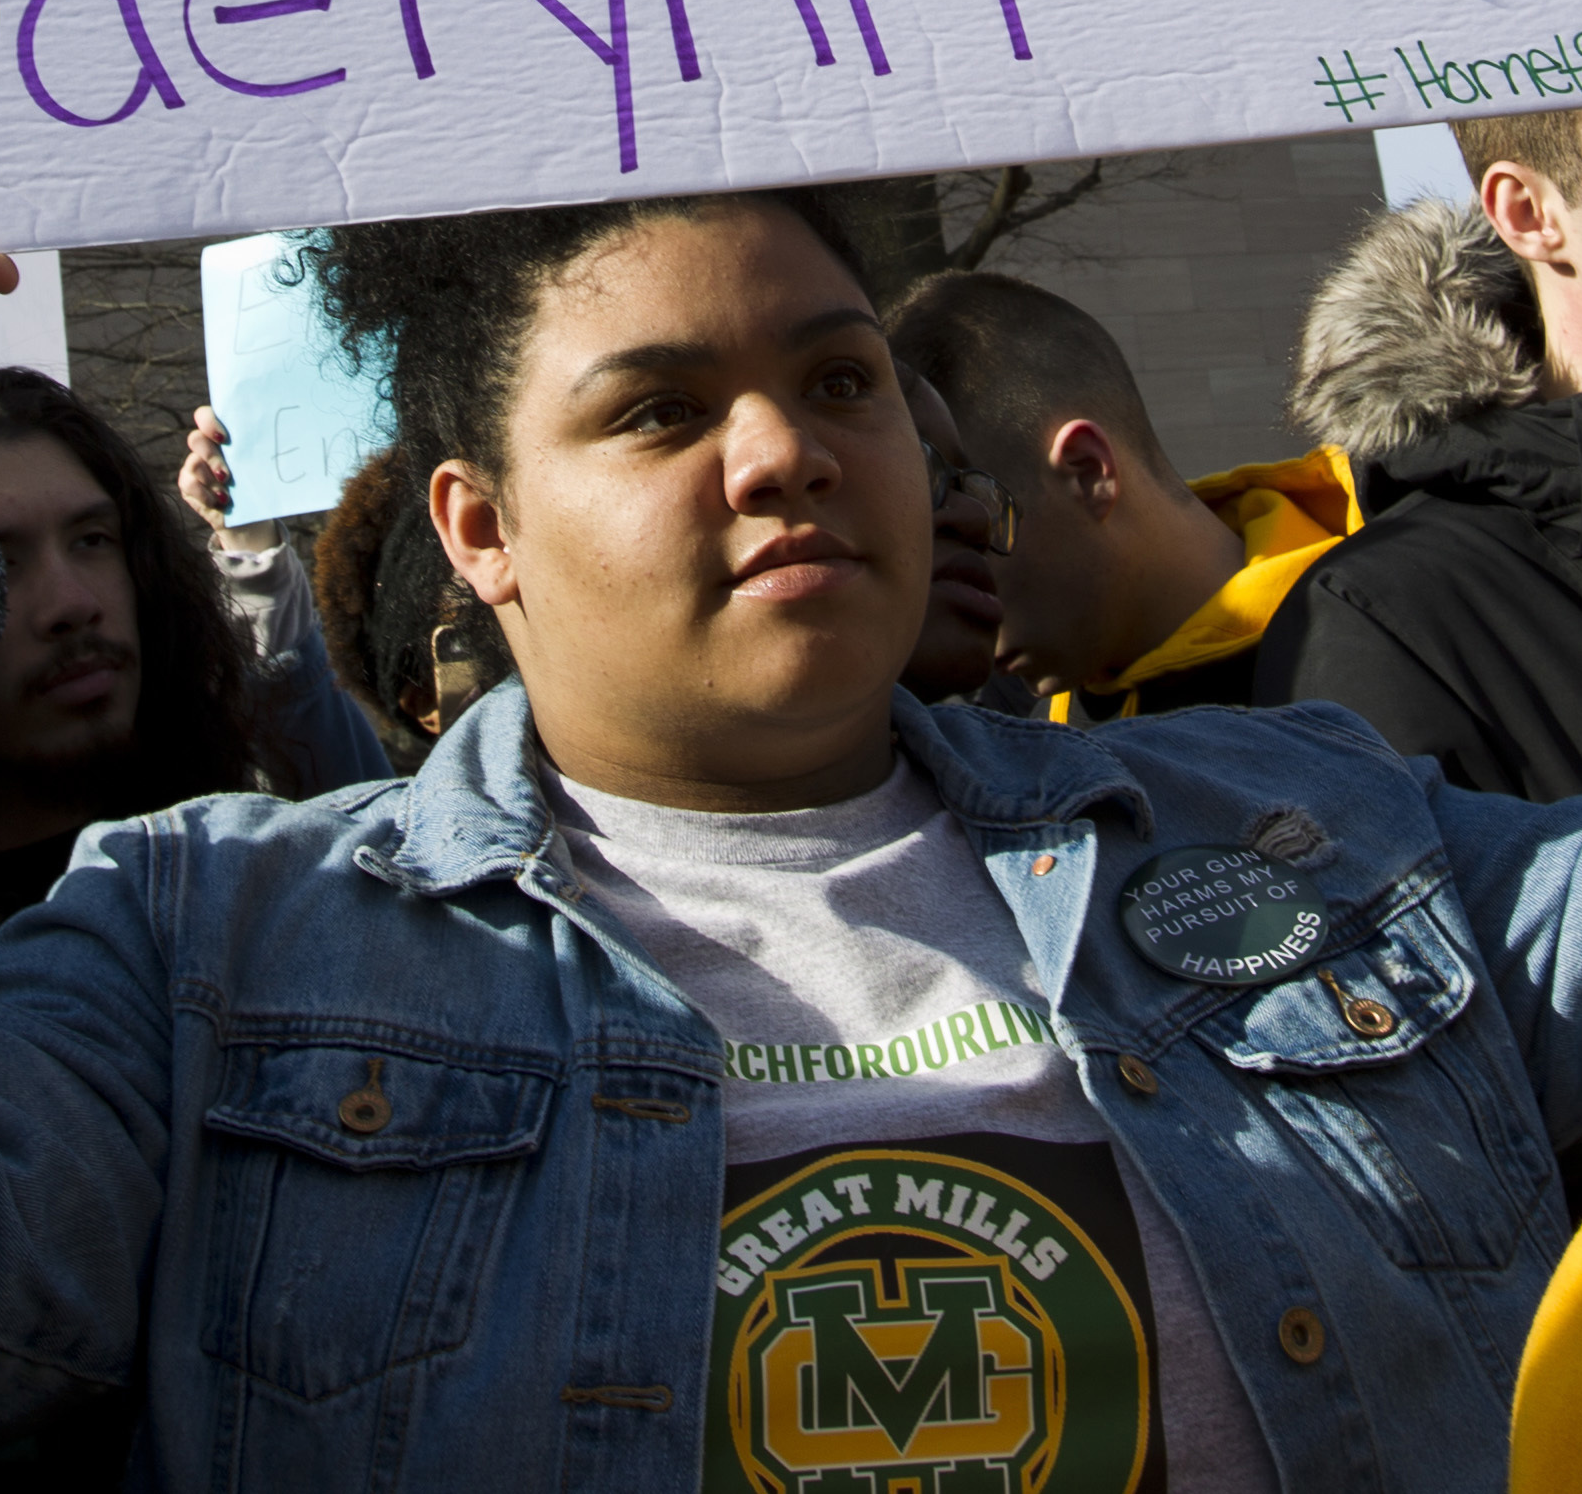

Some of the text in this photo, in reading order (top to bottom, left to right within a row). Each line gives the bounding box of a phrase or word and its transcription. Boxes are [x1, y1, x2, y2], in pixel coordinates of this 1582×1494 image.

[1124, 849, 1261, 903] YOUR GUN
[1140, 864, 1275, 921] HARMS MY
[1145, 879, 1299, 944] PURSUIT OF
[1180, 910, 1322, 977] HAPPINESS
[717, 1173, 1070, 1297] GREAT MILLS
